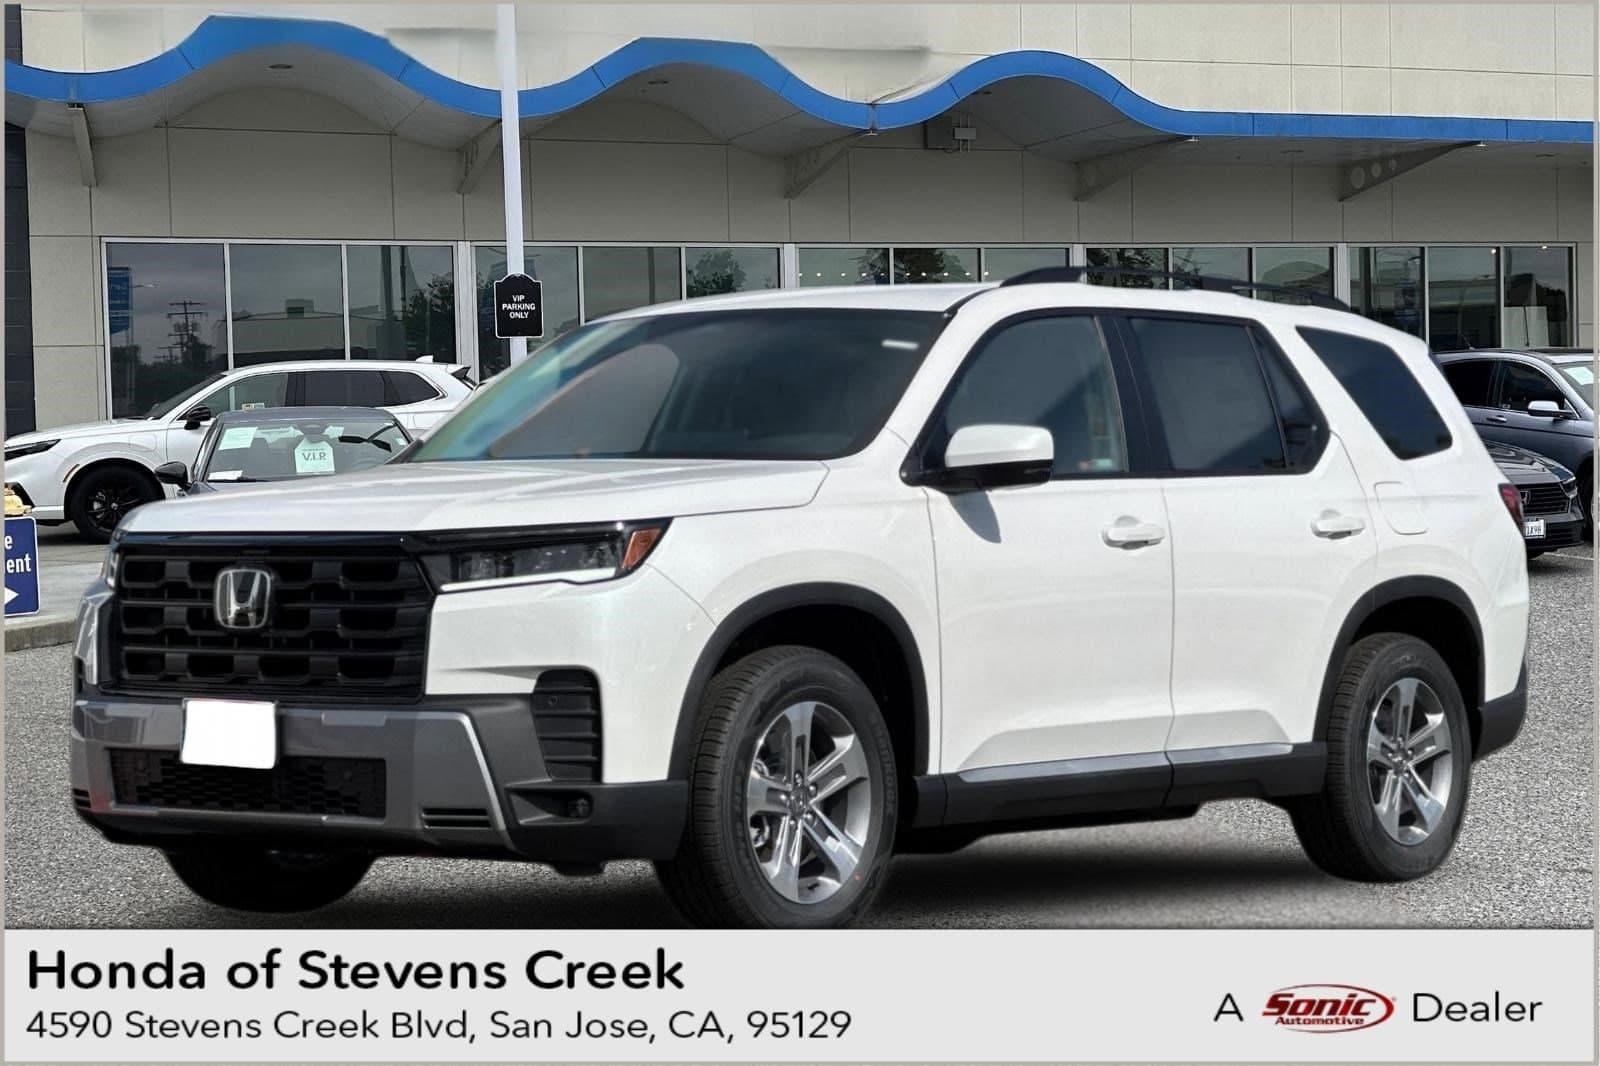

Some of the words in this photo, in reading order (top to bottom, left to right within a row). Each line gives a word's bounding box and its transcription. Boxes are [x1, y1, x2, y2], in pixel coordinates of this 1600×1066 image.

[502, 303, 536, 311] PARKING
[509, 311, 529, 319] ONLY
[6, 553, 31, 573] ent
